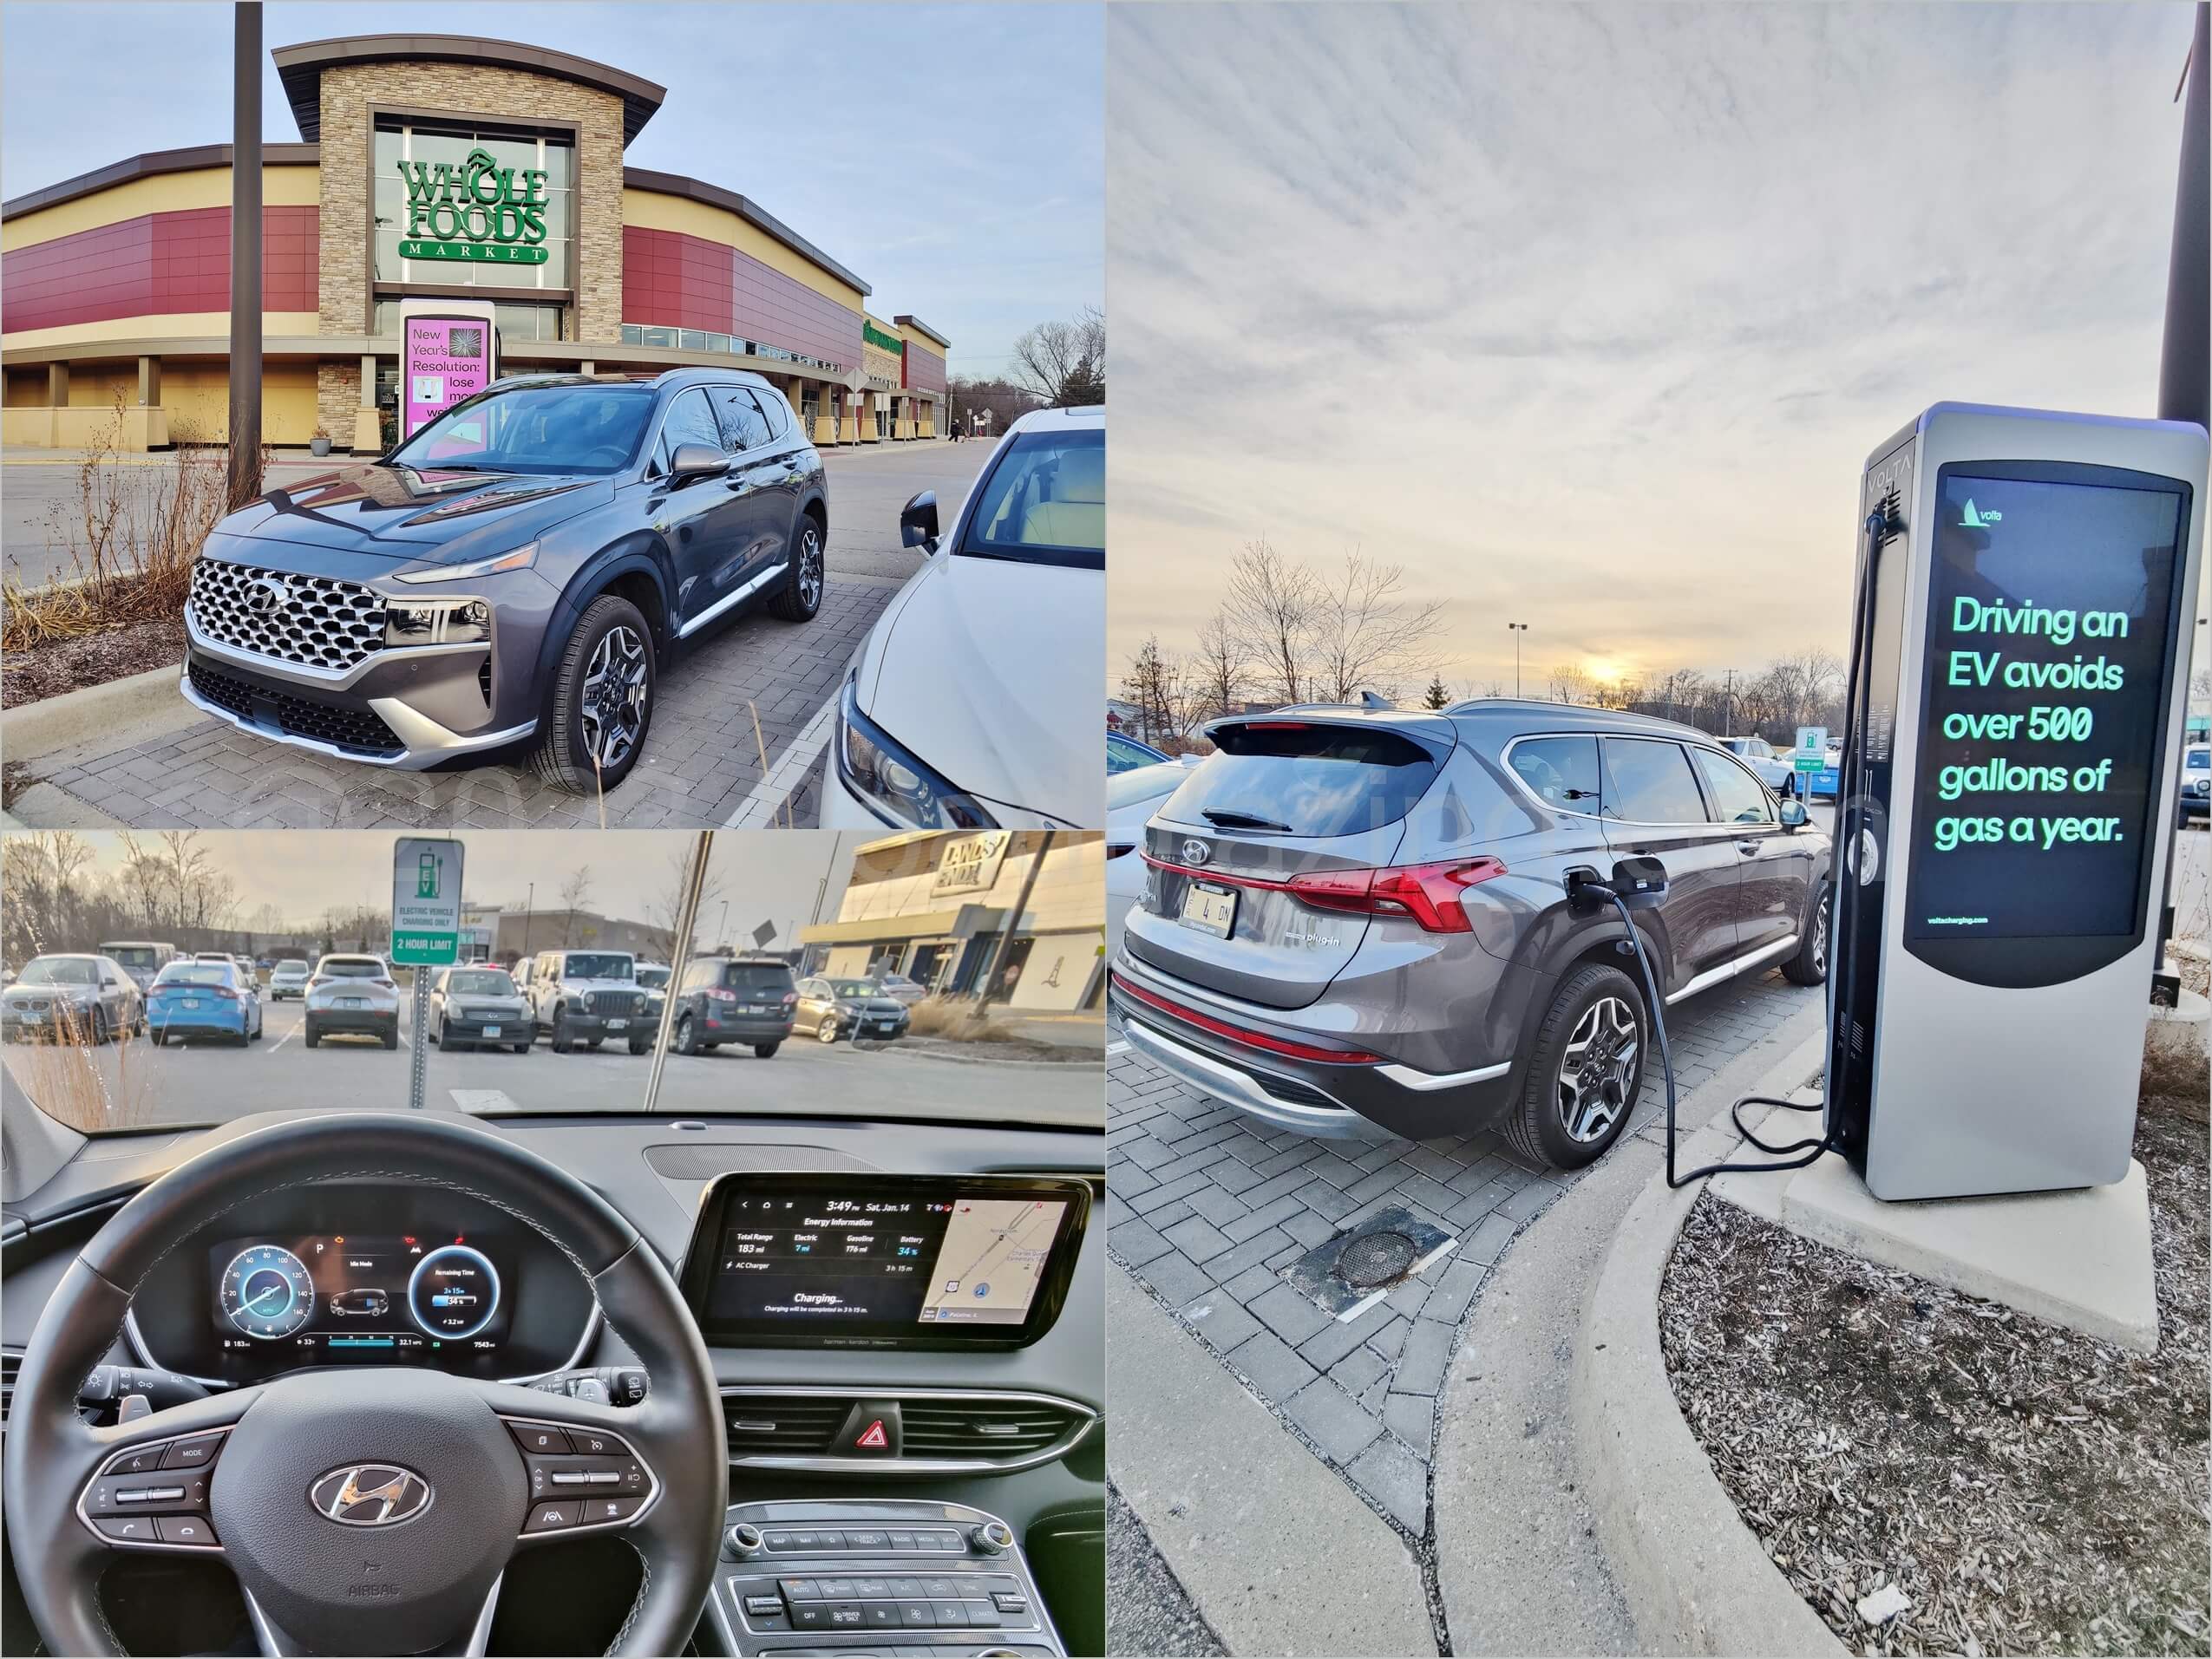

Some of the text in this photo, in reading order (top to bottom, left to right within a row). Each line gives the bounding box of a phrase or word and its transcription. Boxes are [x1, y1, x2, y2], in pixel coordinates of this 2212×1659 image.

[397, 150, 549, 207] WHOLE
[406, 199, 548, 244] FOODS
[409, 244, 542, 261] MARKET
[413, 329, 441, 340] New
[412, 345, 448, 356] Year's
[412, 361, 481, 373] Resolution:
[449, 376, 474, 388] lose
[1980, 510, 2003, 521] volta
[1953, 596, 2129, 645] Driving an
[1948, 650, 2124, 690] EV avoids
[1943, 706, 2094, 741] over 500
[1939, 758, 2113, 800] gallons of
[1934, 817, 2124, 852] gas a year.
[399, 907, 454, 917] ELECTRIC VEHICLE
[402, 918, 450, 927] CHARGING ONLY
[397, 938, 453, 951] 2 HOUR LIMIT
[1306, 932, 1340, 947] plug-in
[827, 1201, 852, 1212] 3:49
[900, 1204, 911, 1212] 14
[804, 1218, 874, 1227] Energy Information
[753, 1233, 774, 1243] Range
[900, 1236, 925, 1244] Battery
[316, 1244, 324, 1254] P
[737, 1244, 755, 1253] 183
[897, 1247, 910, 1256] 34
[746, 1262, 770, 1270] Charger
[794, 1292, 844, 1304] Charging...
[182, 1449, 202, 1458] MODE
[349, 1584, 401, 1597] AIRBAG
